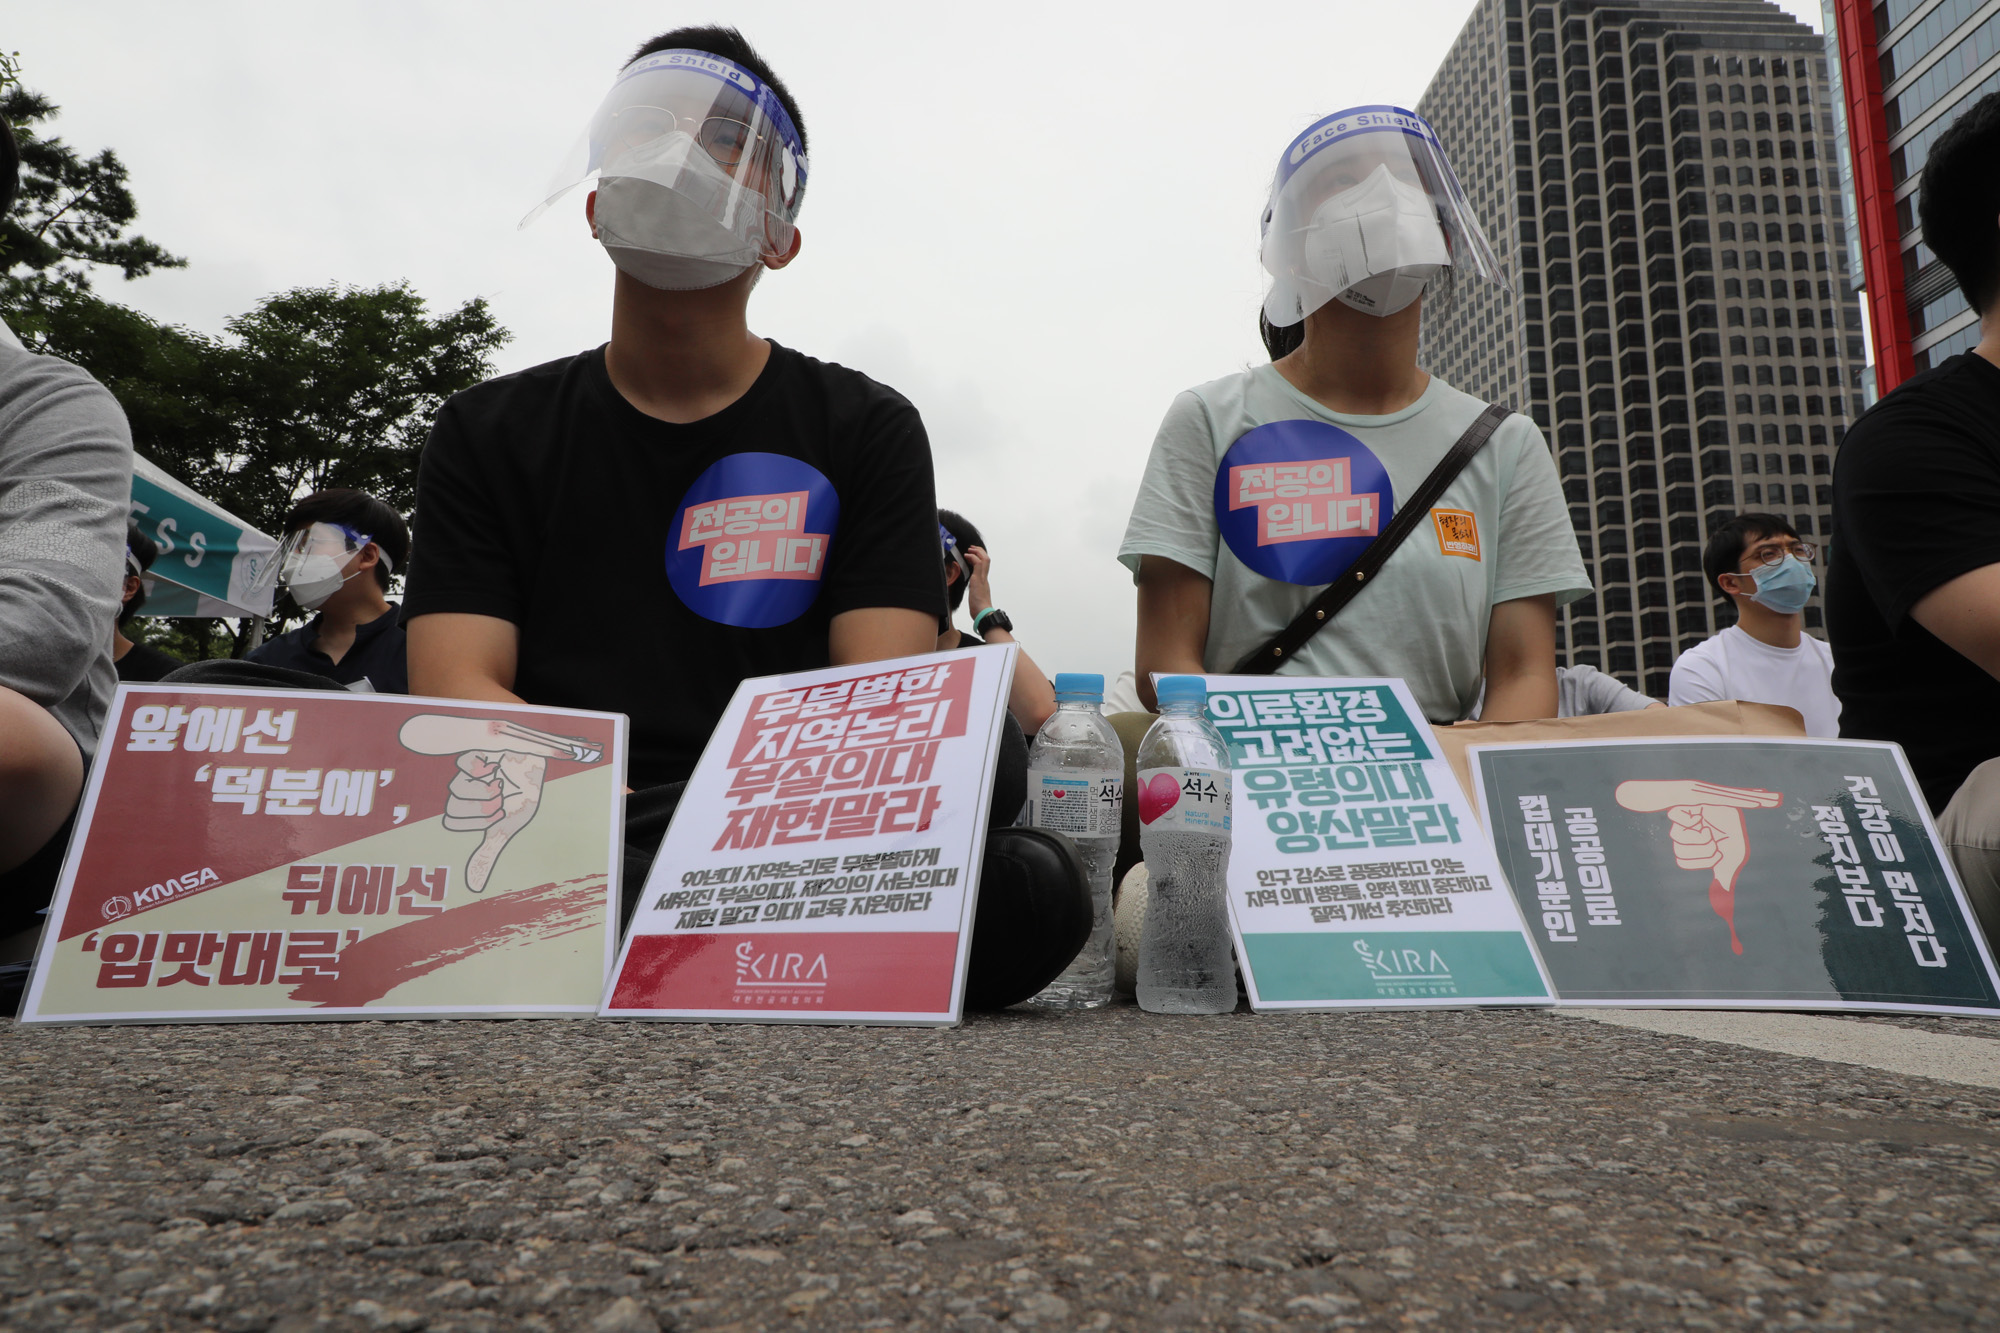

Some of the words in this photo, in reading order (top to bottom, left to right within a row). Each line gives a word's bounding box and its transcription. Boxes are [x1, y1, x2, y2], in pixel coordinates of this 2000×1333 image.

[669, 55, 741, 82] Shield
[1301, 124, 1347, 154] Face
[1357, 114, 1421, 132] Shield
[1239, 463, 1344, 503] 전공의
[688, 496, 801, 543] 전공의
[1266, 497, 1373, 538] 입니다
[709, 537, 822, 578] 입니다
[753, 664, 951, 725] 무분별한
[1209, 690, 1387, 727] 의료환경
[125, 705, 299, 755] 앞에선
[742, 698, 953, 764] 지역논리
[1231, 724, 1413, 764] 고려없는
[724, 739, 943, 806] 부실의대
[1182, 778, 1218, 804] 석수
[1242, 762, 1434, 809] 유령의대
[711, 785, 942, 852] 재현말라
[1185, 810, 1209, 818] Natural
[1185, 817, 1208, 826] Mineral
[1266, 803, 1462, 854] 양산말라
[681, 865, 742, 888] 90년대
[742, 856, 840, 882] 지역논리로
[841, 848, 942, 873] 무분별하게
[1256, 869, 1292, 887] 인구
[1293, 865, 1347, 884] 감소로
[1347, 860, 1431, 881] 공동화되고
[1431, 858, 1466, 874] 있는
[1518, 794, 1578, 942] 껍데기뿐인
[1564, 807, 1622, 926] 공공의료
[1811, 805, 1884, 928] 정치보다
[1844, 775, 1905, 863] 건강이
[1881, 870, 1948, 968] 먼저다
[133, 867, 219, 907] KMSA
[281, 863, 450, 917] 뒤에선
[653, 887, 719, 911] 세워진
[717, 880, 797, 905] 부실의대,
[873, 867, 959, 891] 서남의대
[1244, 888, 1280, 908] 지역
[1280, 886, 1315, 905] 의대
[1314, 883, 1367, 903] 병원들,
[1366, 881, 1399, 899] 양적
[1400, 879, 1433, 897] 확대
[1431, 875, 1493, 895] 중단하고
[674, 909, 719, 930] 재현
[718, 904, 760, 926] 말고
[763, 898, 805, 922] 의대
[805, 897, 848, 919] 교육
[848, 891, 933, 916] 지원하라
[1309, 904, 1347, 923] 질적
[1349, 901, 1385, 920] 개선
[1385, 897, 1453, 918] 추진하라
[751, 953, 827, 979] KIRA
[1376, 949, 1449, 972] KIRA
